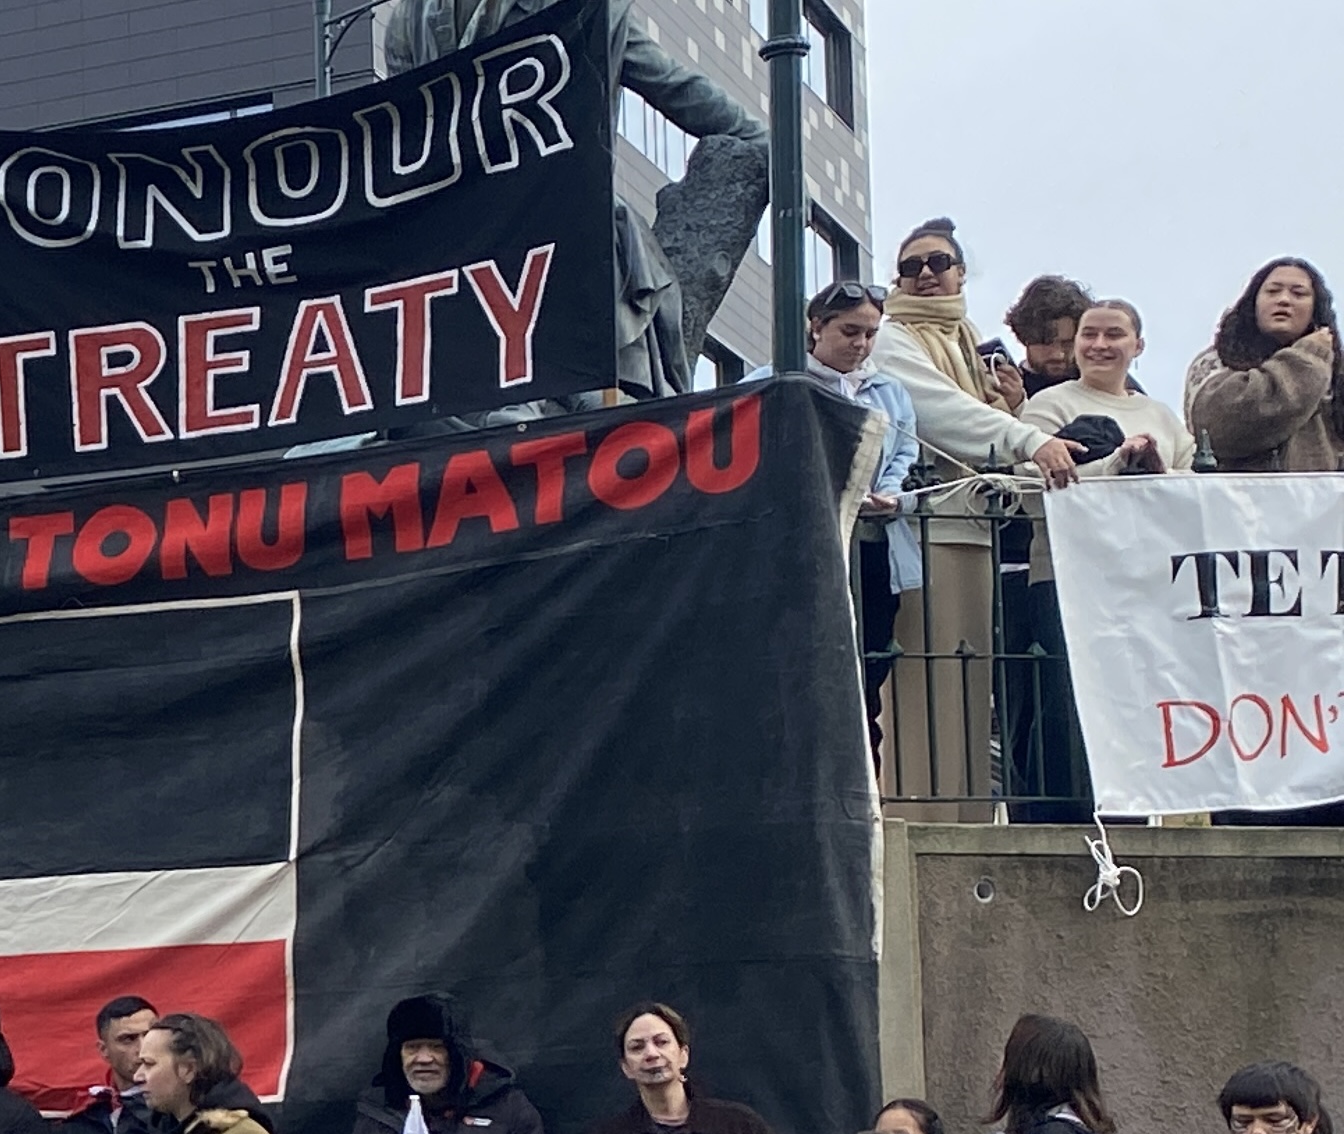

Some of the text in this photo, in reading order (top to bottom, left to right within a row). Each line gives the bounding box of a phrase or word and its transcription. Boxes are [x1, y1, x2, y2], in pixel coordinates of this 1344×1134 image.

[188, 244, 297, 293] THE
[9, 483, 310, 589] TONU
[341, 394, 762, 561] MATOU
[1171, 549, 1302, 620] TE
[1157, 692, 1344, 768] DON'
